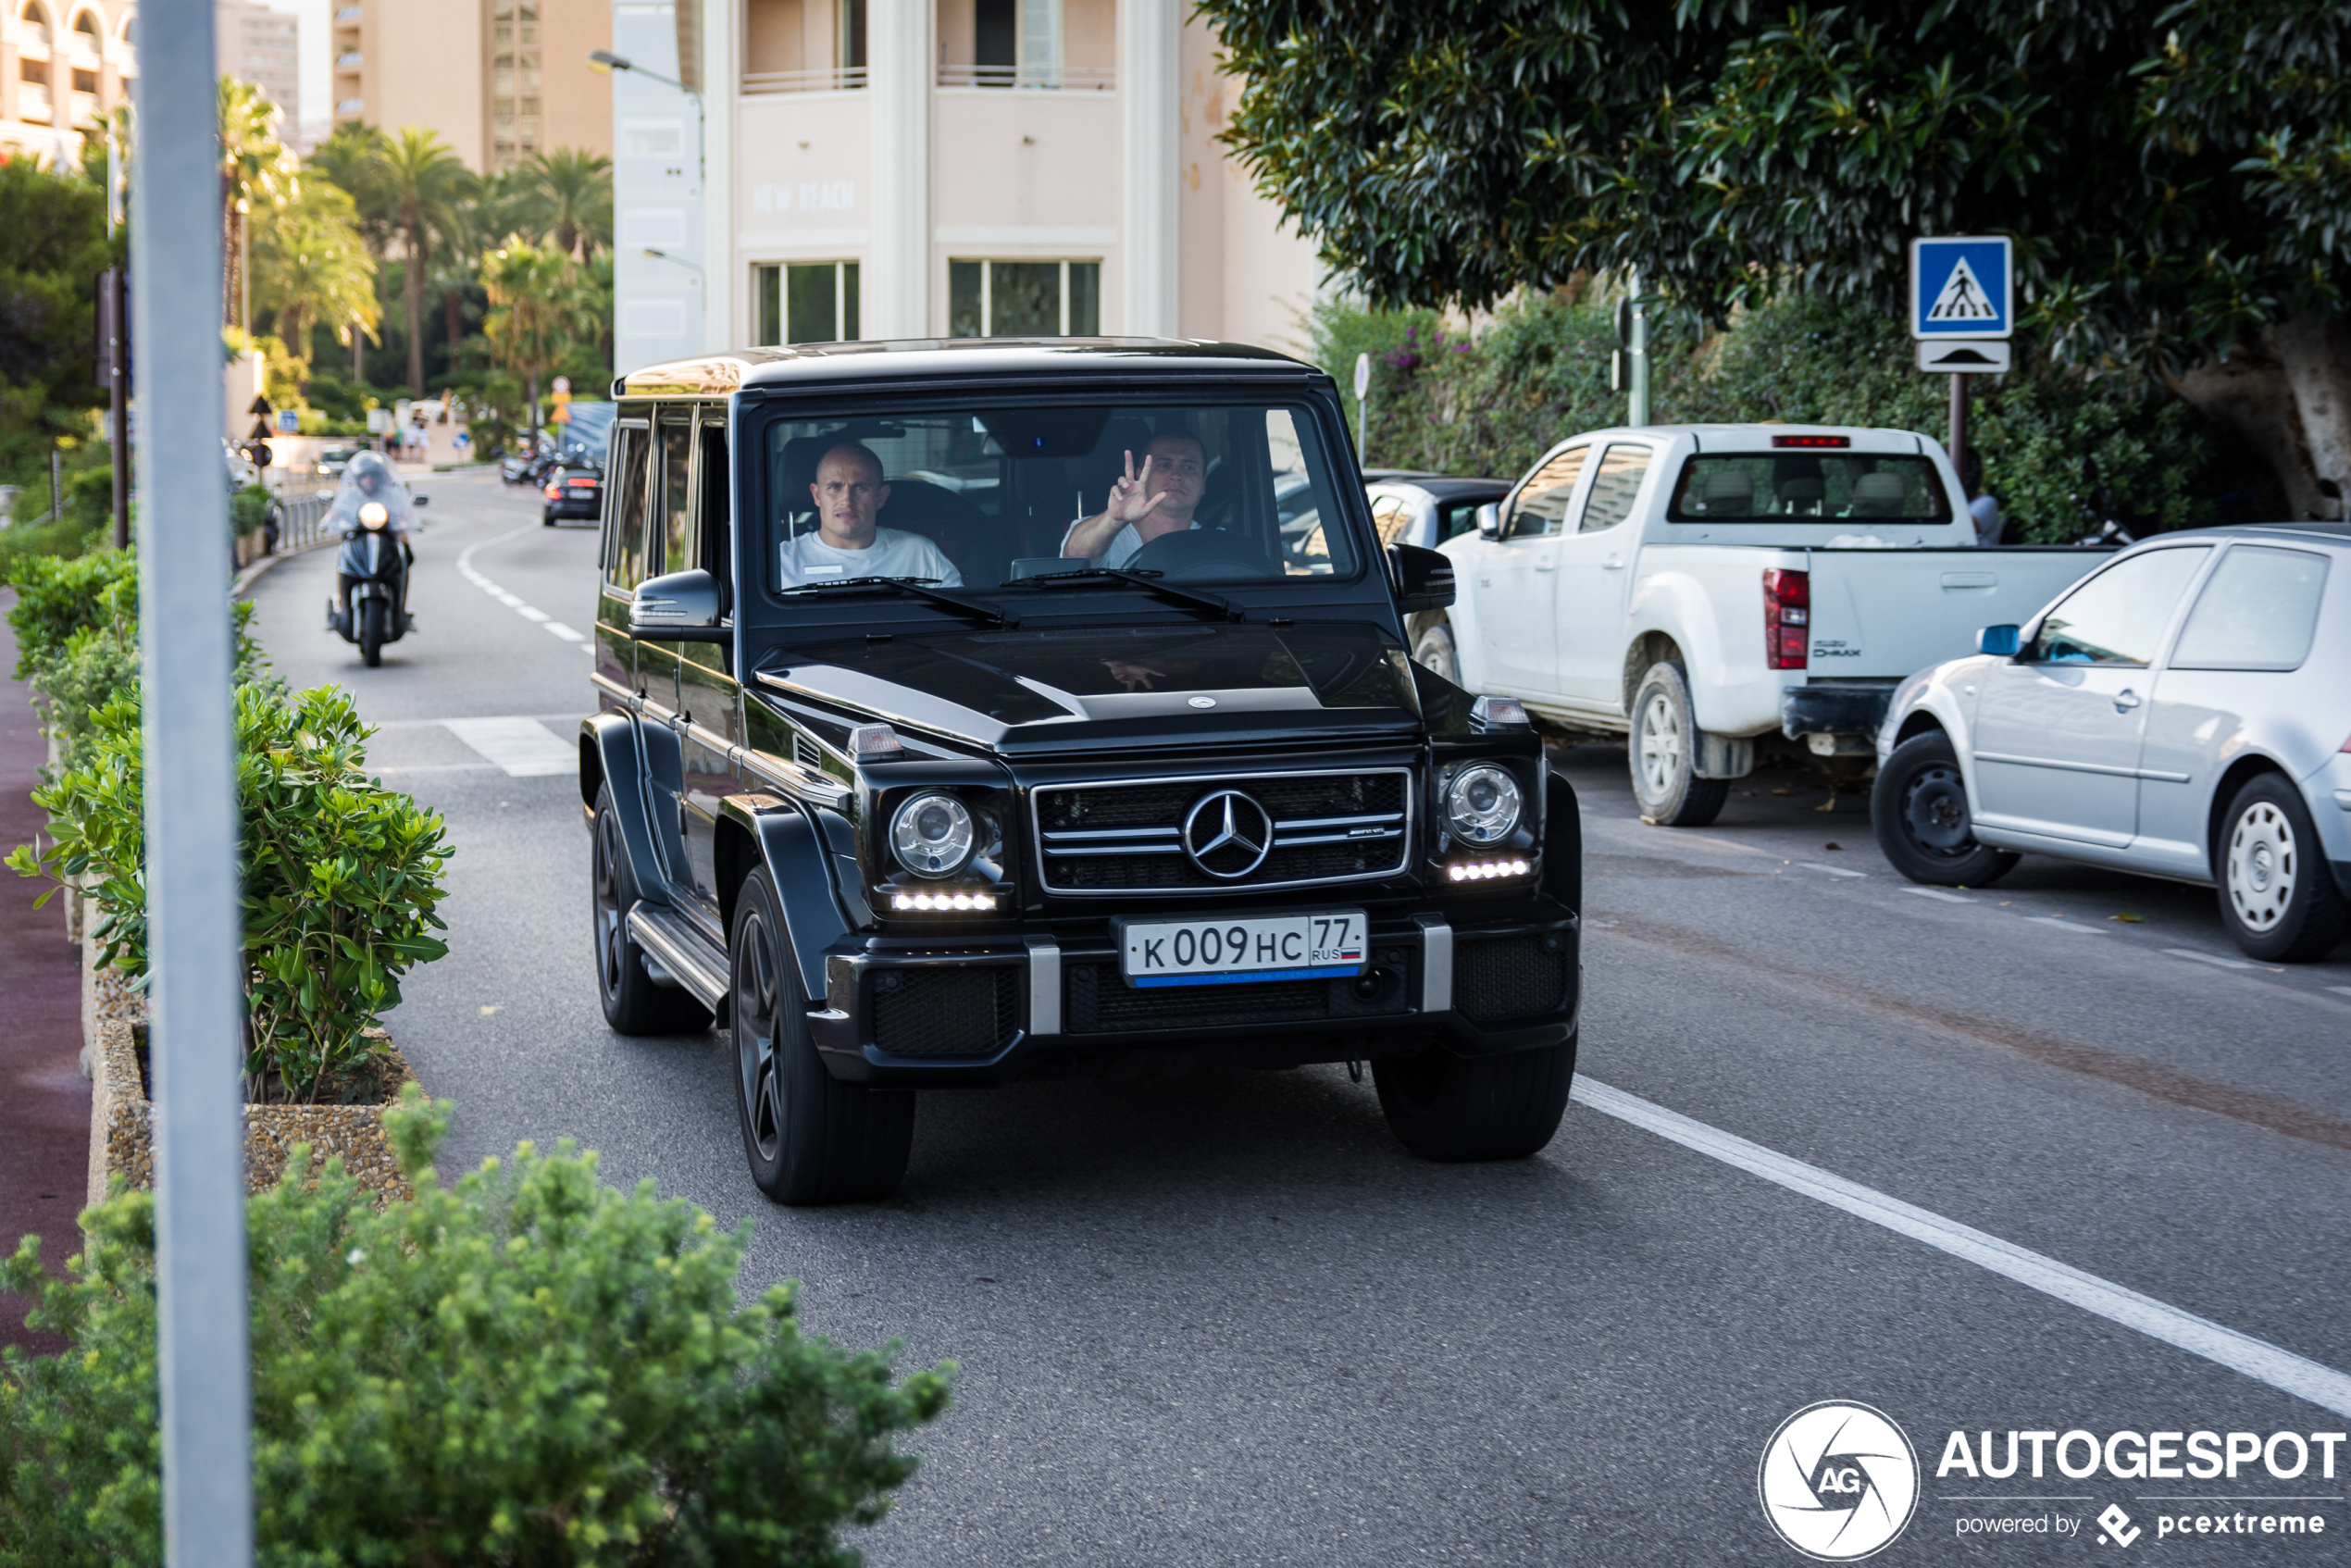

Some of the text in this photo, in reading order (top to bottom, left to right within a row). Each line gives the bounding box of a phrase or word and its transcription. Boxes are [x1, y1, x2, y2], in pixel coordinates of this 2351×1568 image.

[753, 180, 855, 214] NEW BEACH
[1313, 918, 1350, 949] 77
[1312, 949, 1340, 961] RUS
